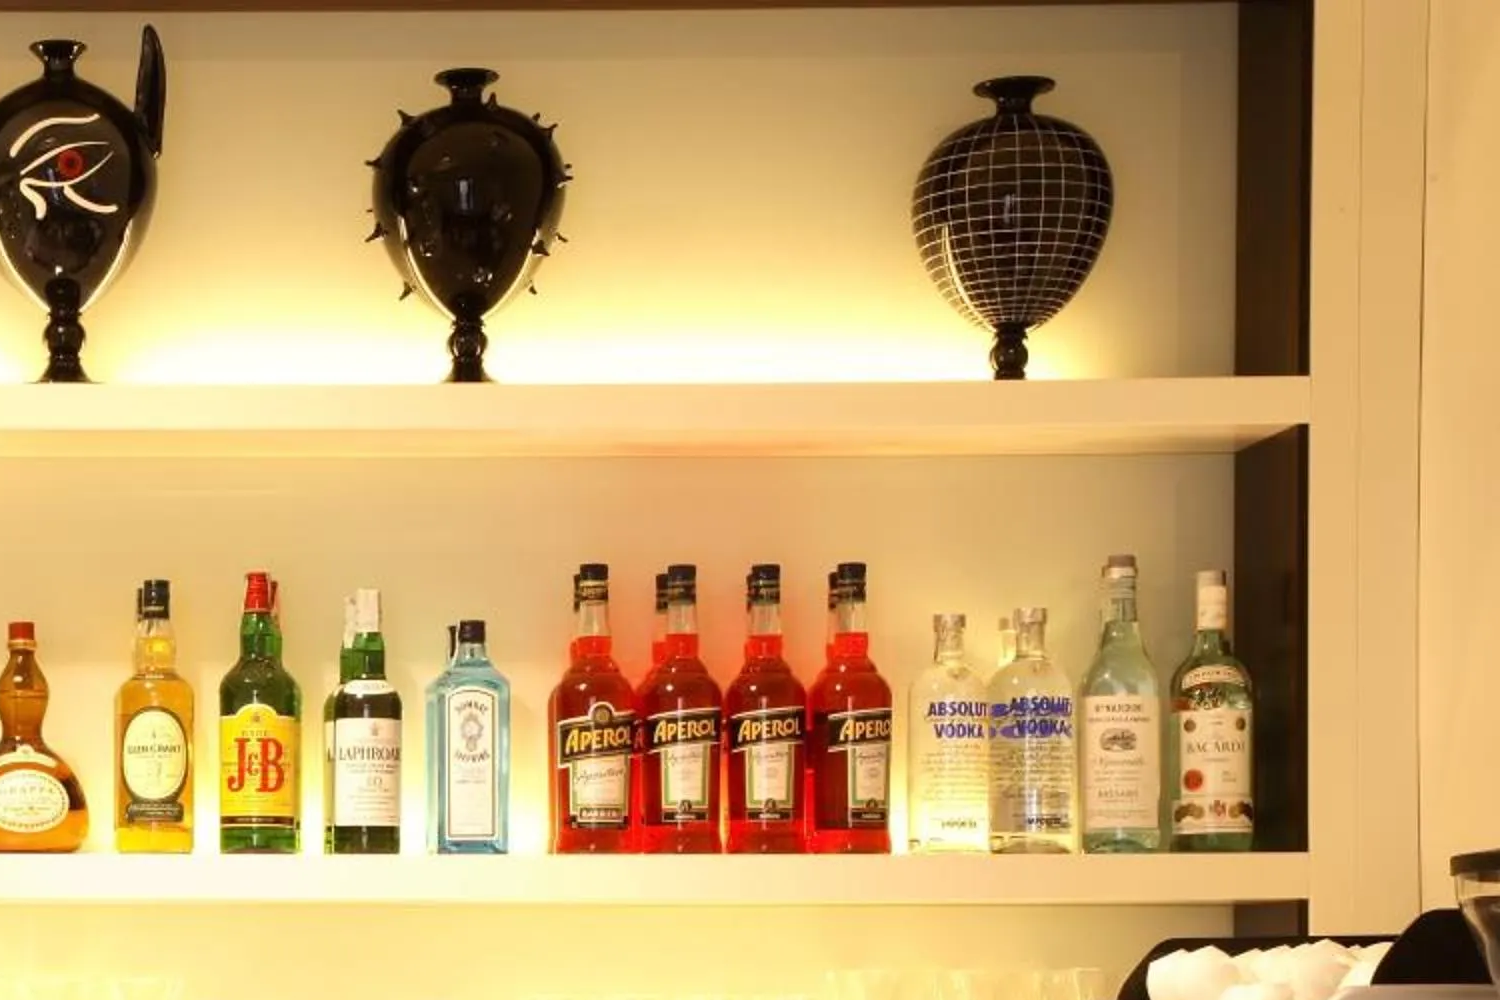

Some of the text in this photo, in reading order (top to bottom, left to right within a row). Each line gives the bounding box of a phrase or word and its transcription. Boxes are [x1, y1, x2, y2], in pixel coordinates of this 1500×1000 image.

[927, 701, 988, 717] ABSOLUT
[565, 725, 632, 755] APEROL
[653, 719, 717, 744] APEROL
[737, 717, 801, 743] APEROL
[839, 718, 892, 742] APERO
[934, 723, 985, 739] VODKA
